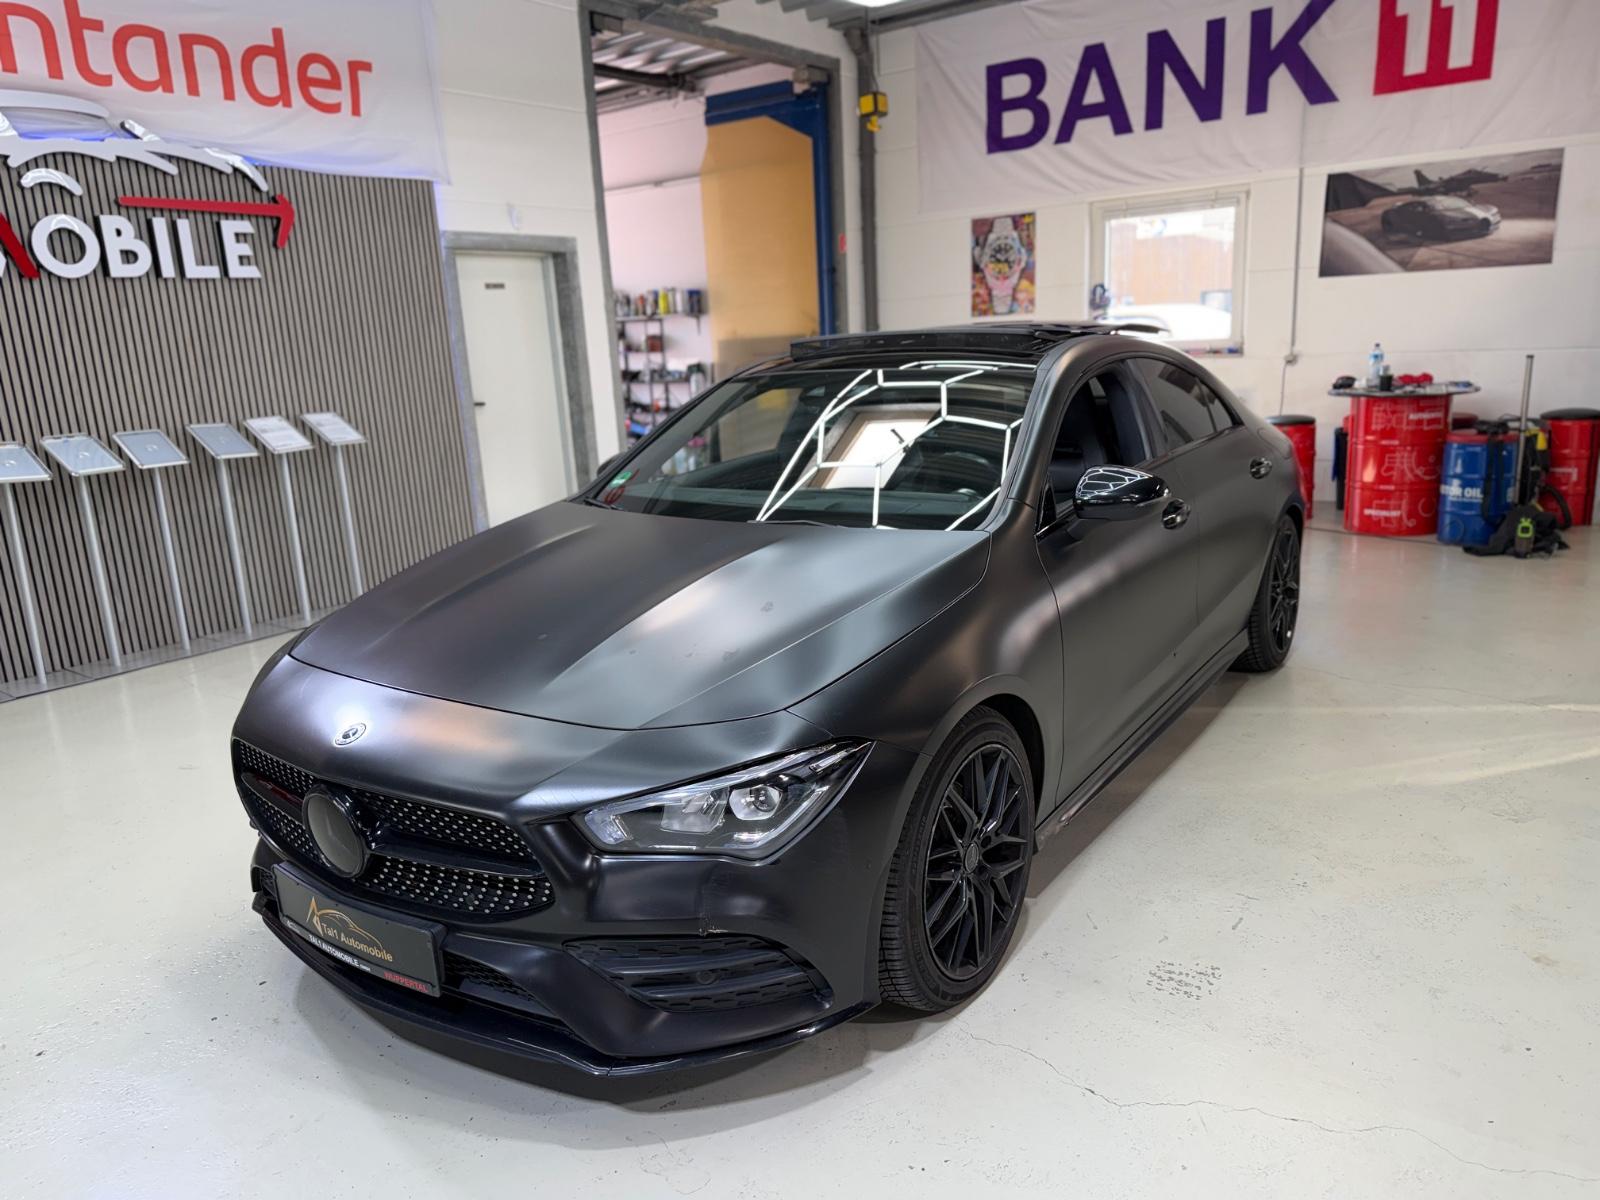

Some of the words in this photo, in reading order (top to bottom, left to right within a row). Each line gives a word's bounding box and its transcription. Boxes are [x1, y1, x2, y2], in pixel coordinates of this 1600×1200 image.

[985, 0, 1340, 155] BANK
[1463, 487, 1484, 499] OIL
[322, 941, 360, 967] AUTOMOBILE
[340, 932, 393, 962] Automobile
